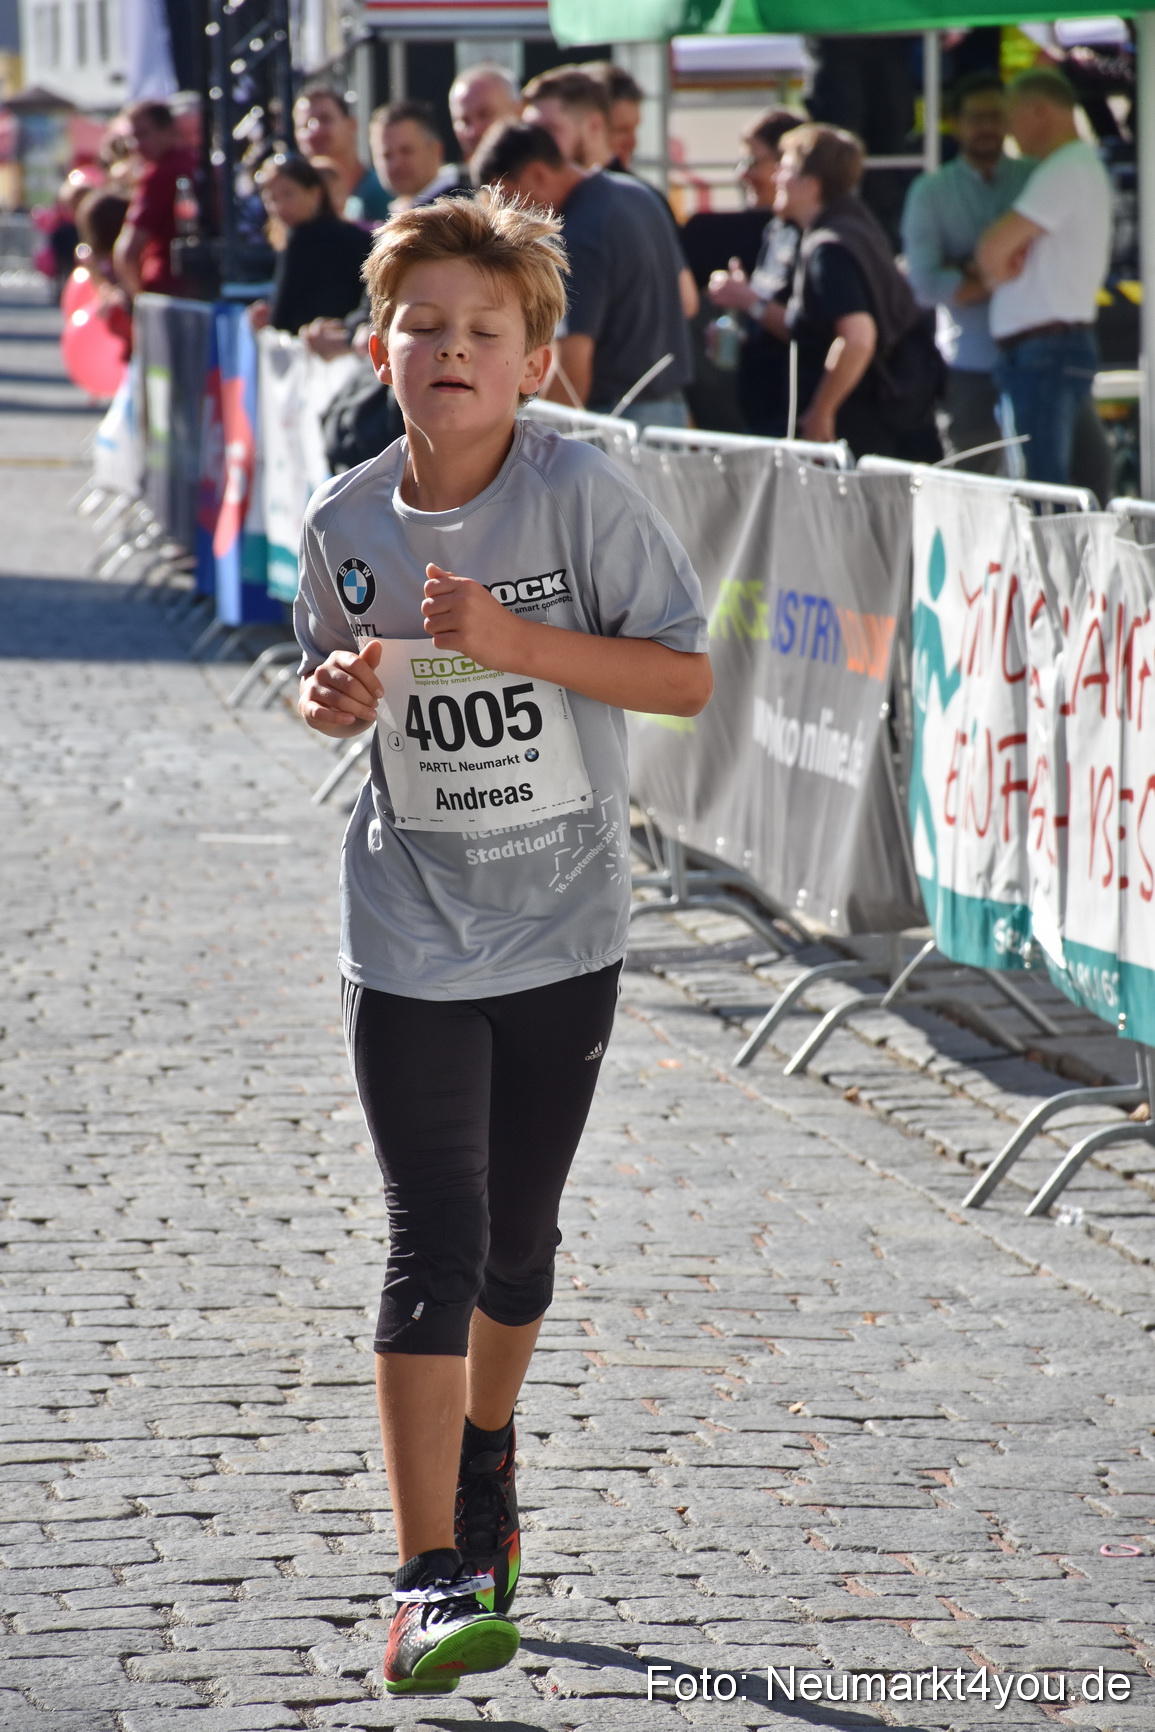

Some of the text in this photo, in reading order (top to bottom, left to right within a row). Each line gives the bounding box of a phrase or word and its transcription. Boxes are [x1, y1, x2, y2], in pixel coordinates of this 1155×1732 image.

[338, 559, 372, 578] BMW
[483, 569, 571, 606] OCK
[514, 594, 573, 614] smart concepts
[415, 671, 505, 687] inspired by smart concepts
[405, 682, 543, 752] 4005
[394, 736, 400, 747] J
[419, 754, 520, 773] PARTL Neumarkt
[436, 782, 534, 811] Andreas
[465, 821, 568, 866] Stadtlauf
[555, 821, 619, 894] 16. September 2018
